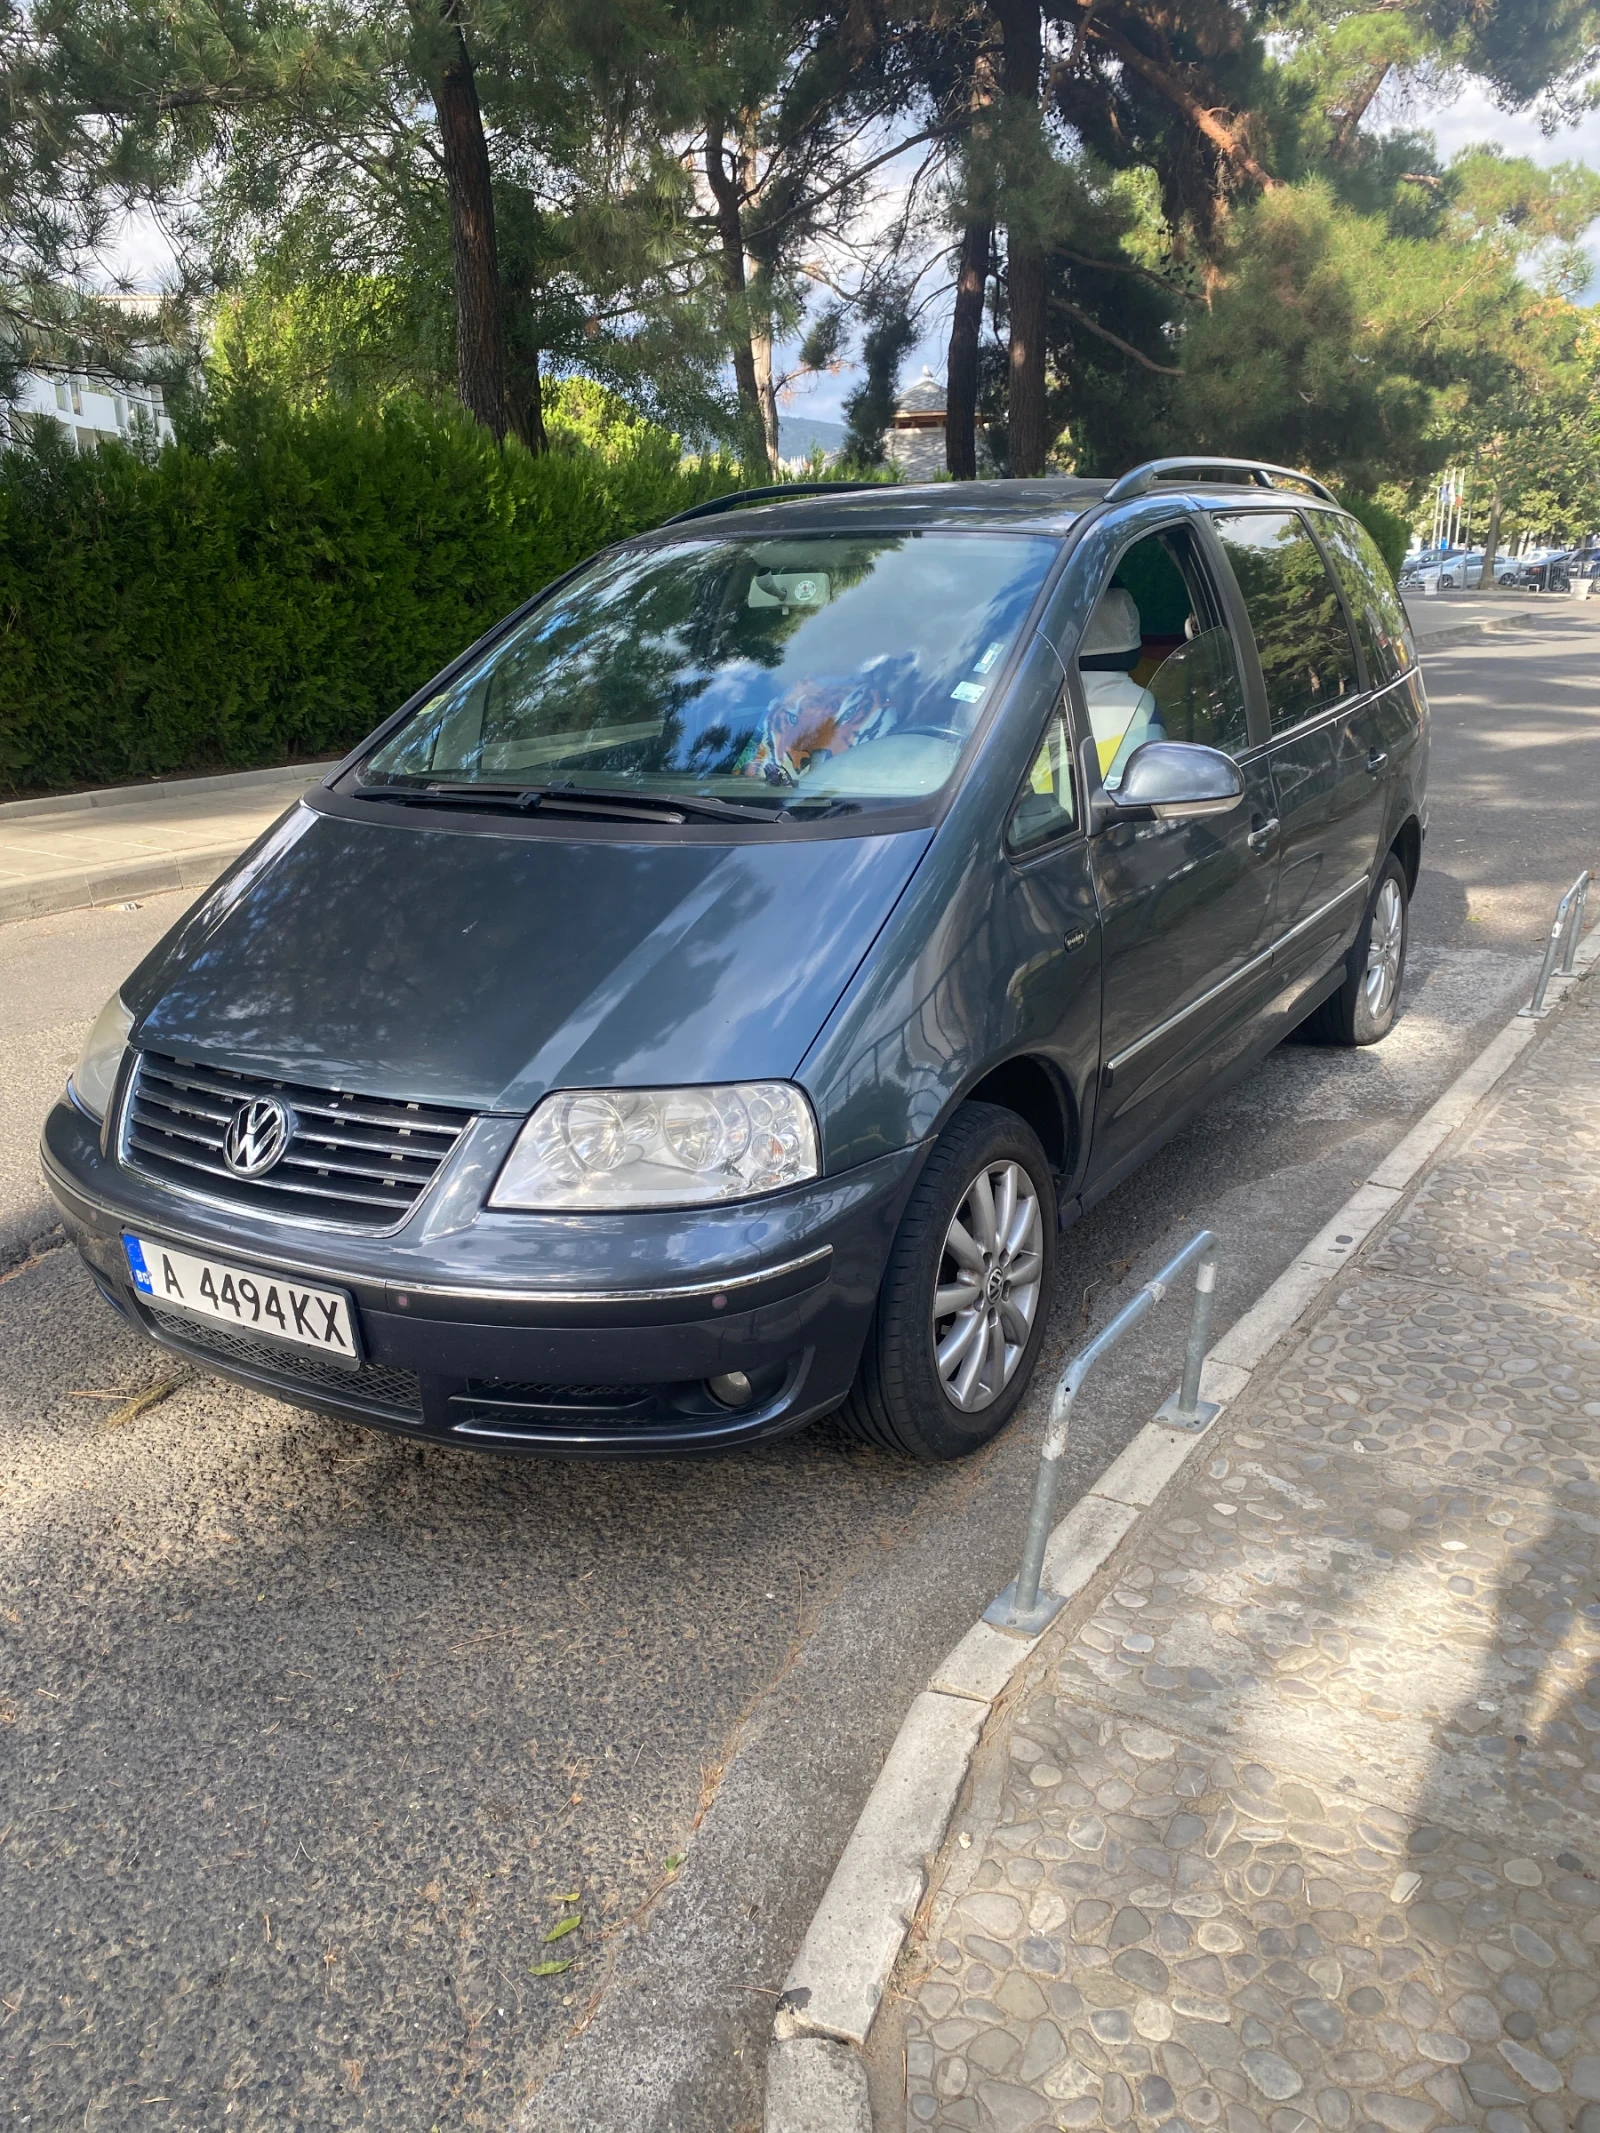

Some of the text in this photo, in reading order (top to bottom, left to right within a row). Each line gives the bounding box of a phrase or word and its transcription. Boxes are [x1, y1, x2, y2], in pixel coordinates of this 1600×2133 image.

[226, 1099, 285, 1173] VW
[135, 1269, 150, 1285] BG
[162, 1253, 347, 1347] A 4494KX
